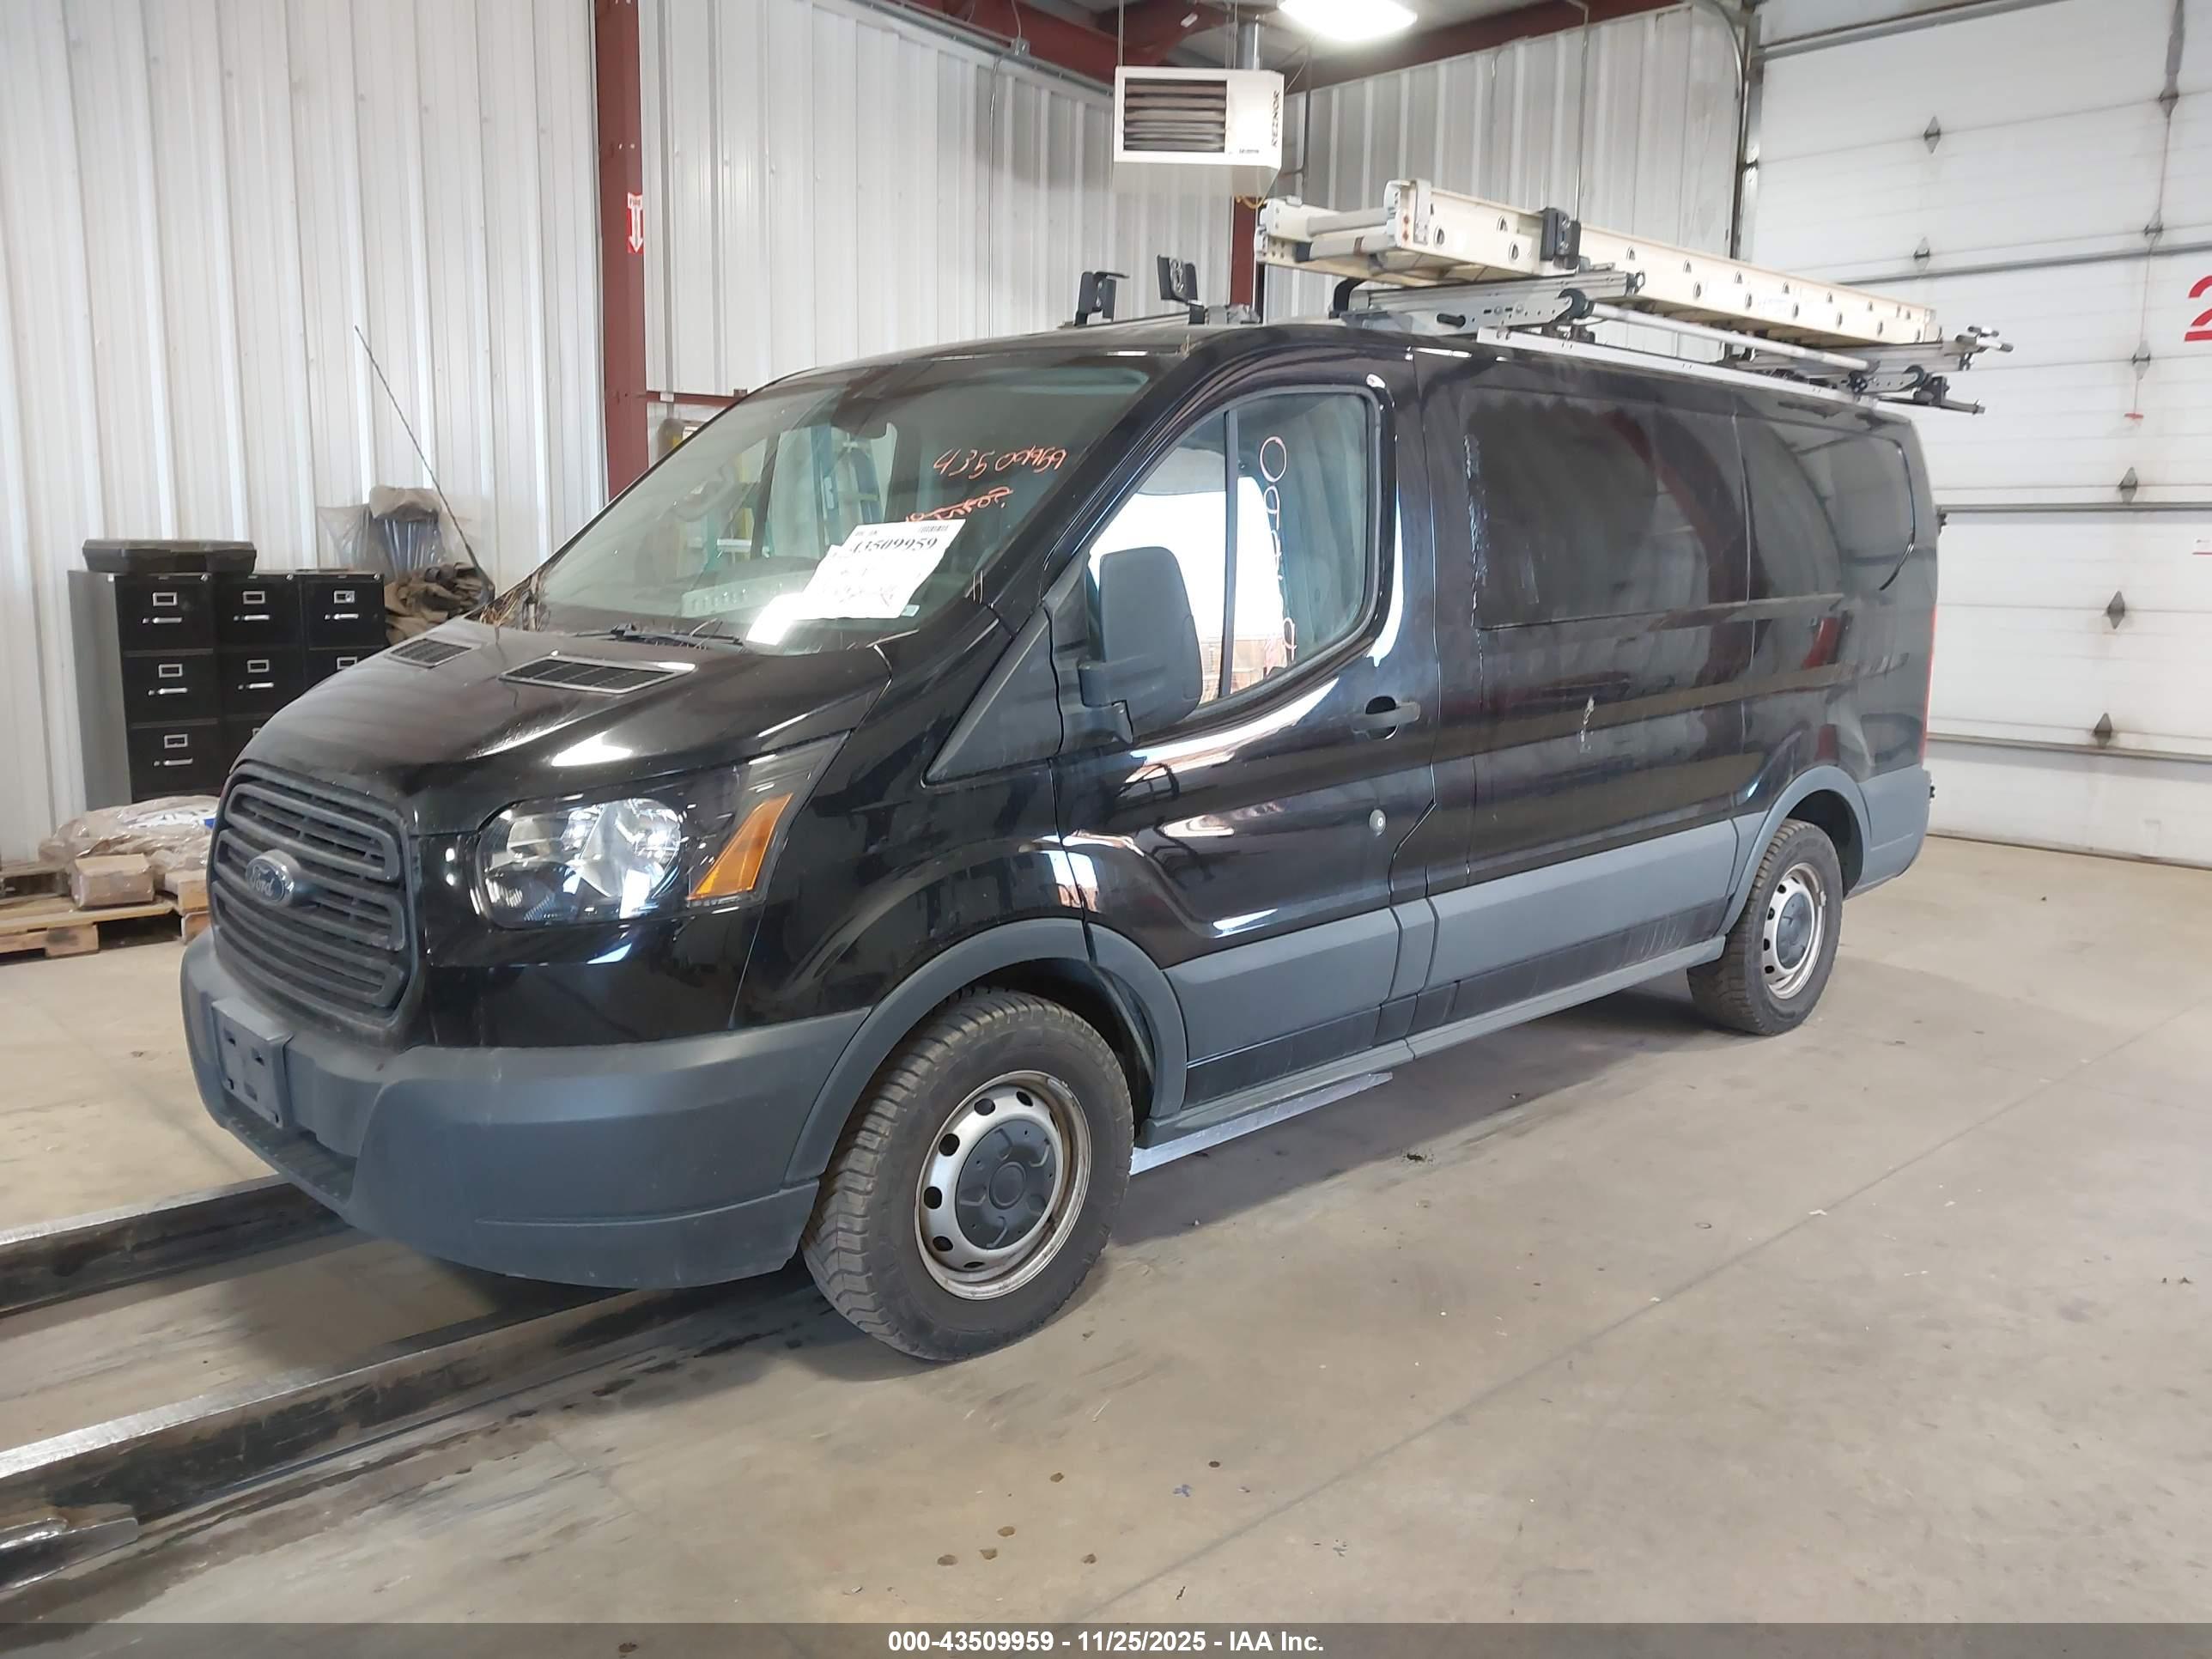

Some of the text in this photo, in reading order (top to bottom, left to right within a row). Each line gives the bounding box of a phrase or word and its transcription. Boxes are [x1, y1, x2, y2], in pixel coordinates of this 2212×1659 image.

[1271, 89, 1281, 148] REZNOR
[850, 538, 939, 554] 43509959
[251, 864, 275, 897] Ford
